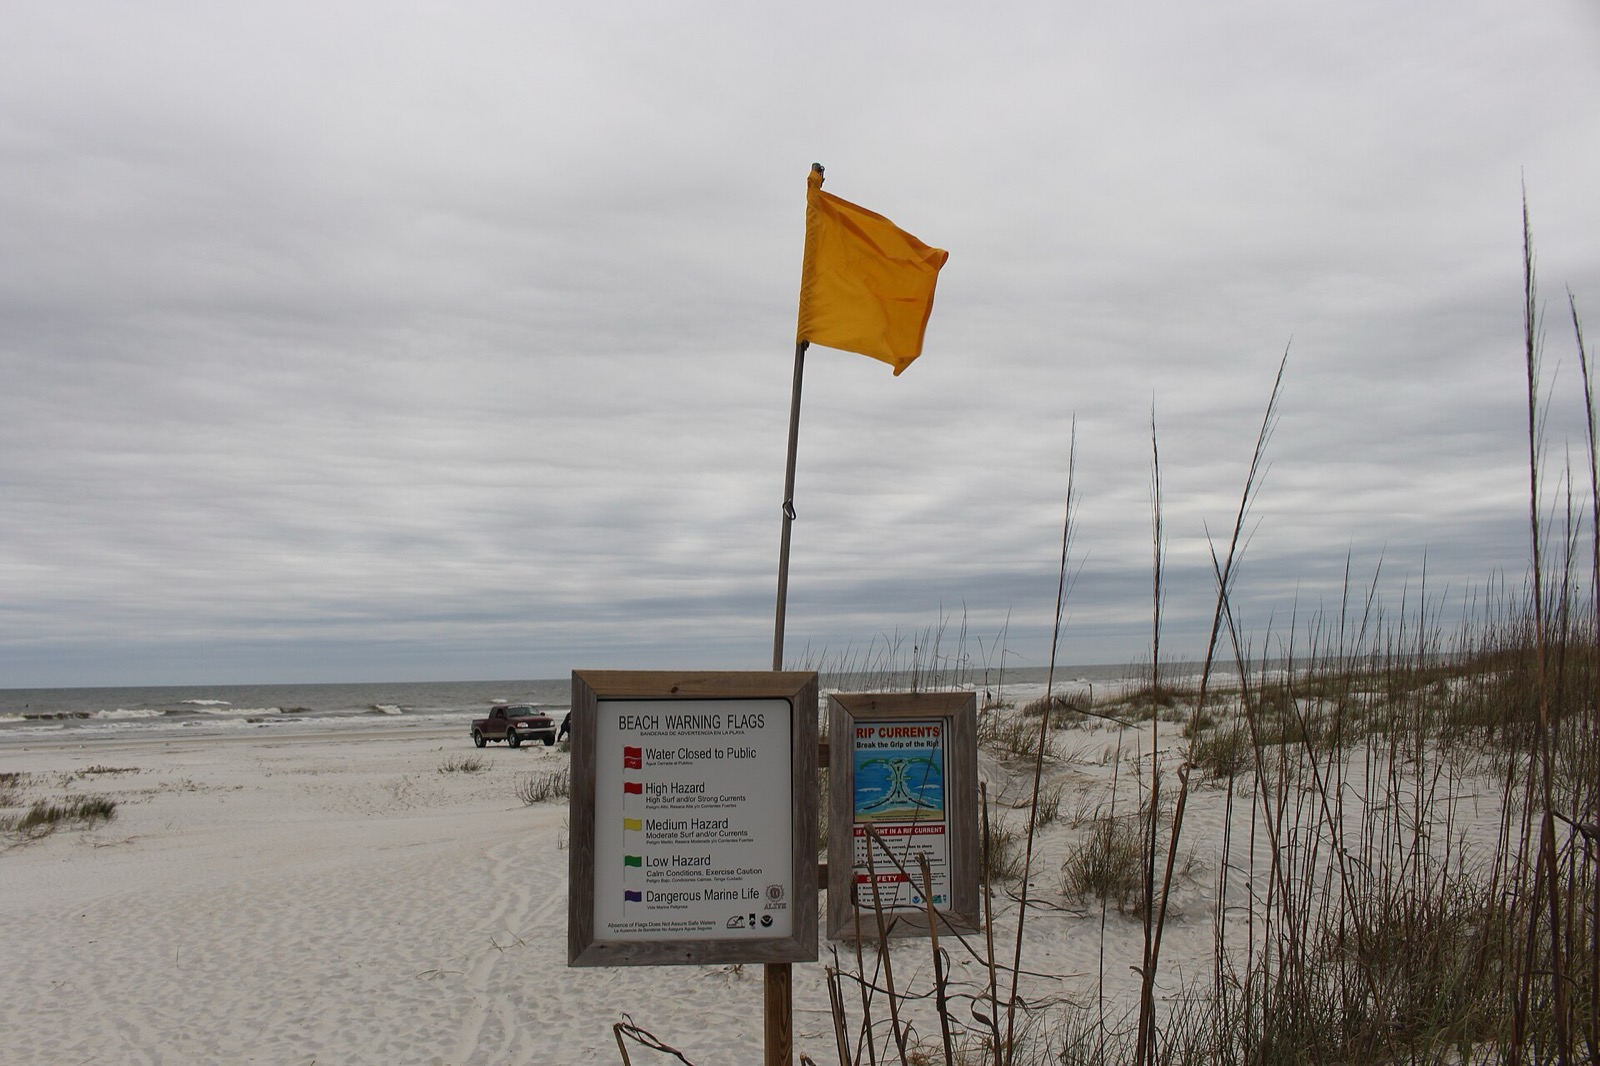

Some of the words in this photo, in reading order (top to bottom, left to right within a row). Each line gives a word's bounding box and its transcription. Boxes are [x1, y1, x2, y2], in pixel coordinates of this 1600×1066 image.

[619, 715, 659, 730] BEACH
[665, 714, 721, 730] WARNING
[727, 713, 765, 729] FLAGS
[856, 727, 875, 738] RIP
[878, 726, 940, 738] CURRENTS
[890, 741, 904, 749] Grip
[926, 740, 939, 748] Rip!
[646, 748, 675, 760] Water
[678, 747, 712, 760] Closed
[714, 748, 724, 759] to
[727, 747, 757, 759] Public
[646, 782, 668, 796] High
[670, 782, 705, 794] Hazard
[698, 796, 718, 804] Strong
[646, 819, 688, 831] Medium
[691, 818, 728, 830] Hazard
[646, 856, 668, 867] Low
[672, 854, 711, 866] Hazard
[646, 890, 701, 904] Dangerous
[704, 888, 738, 900] Marine
[741, 887, 760, 899] Life
